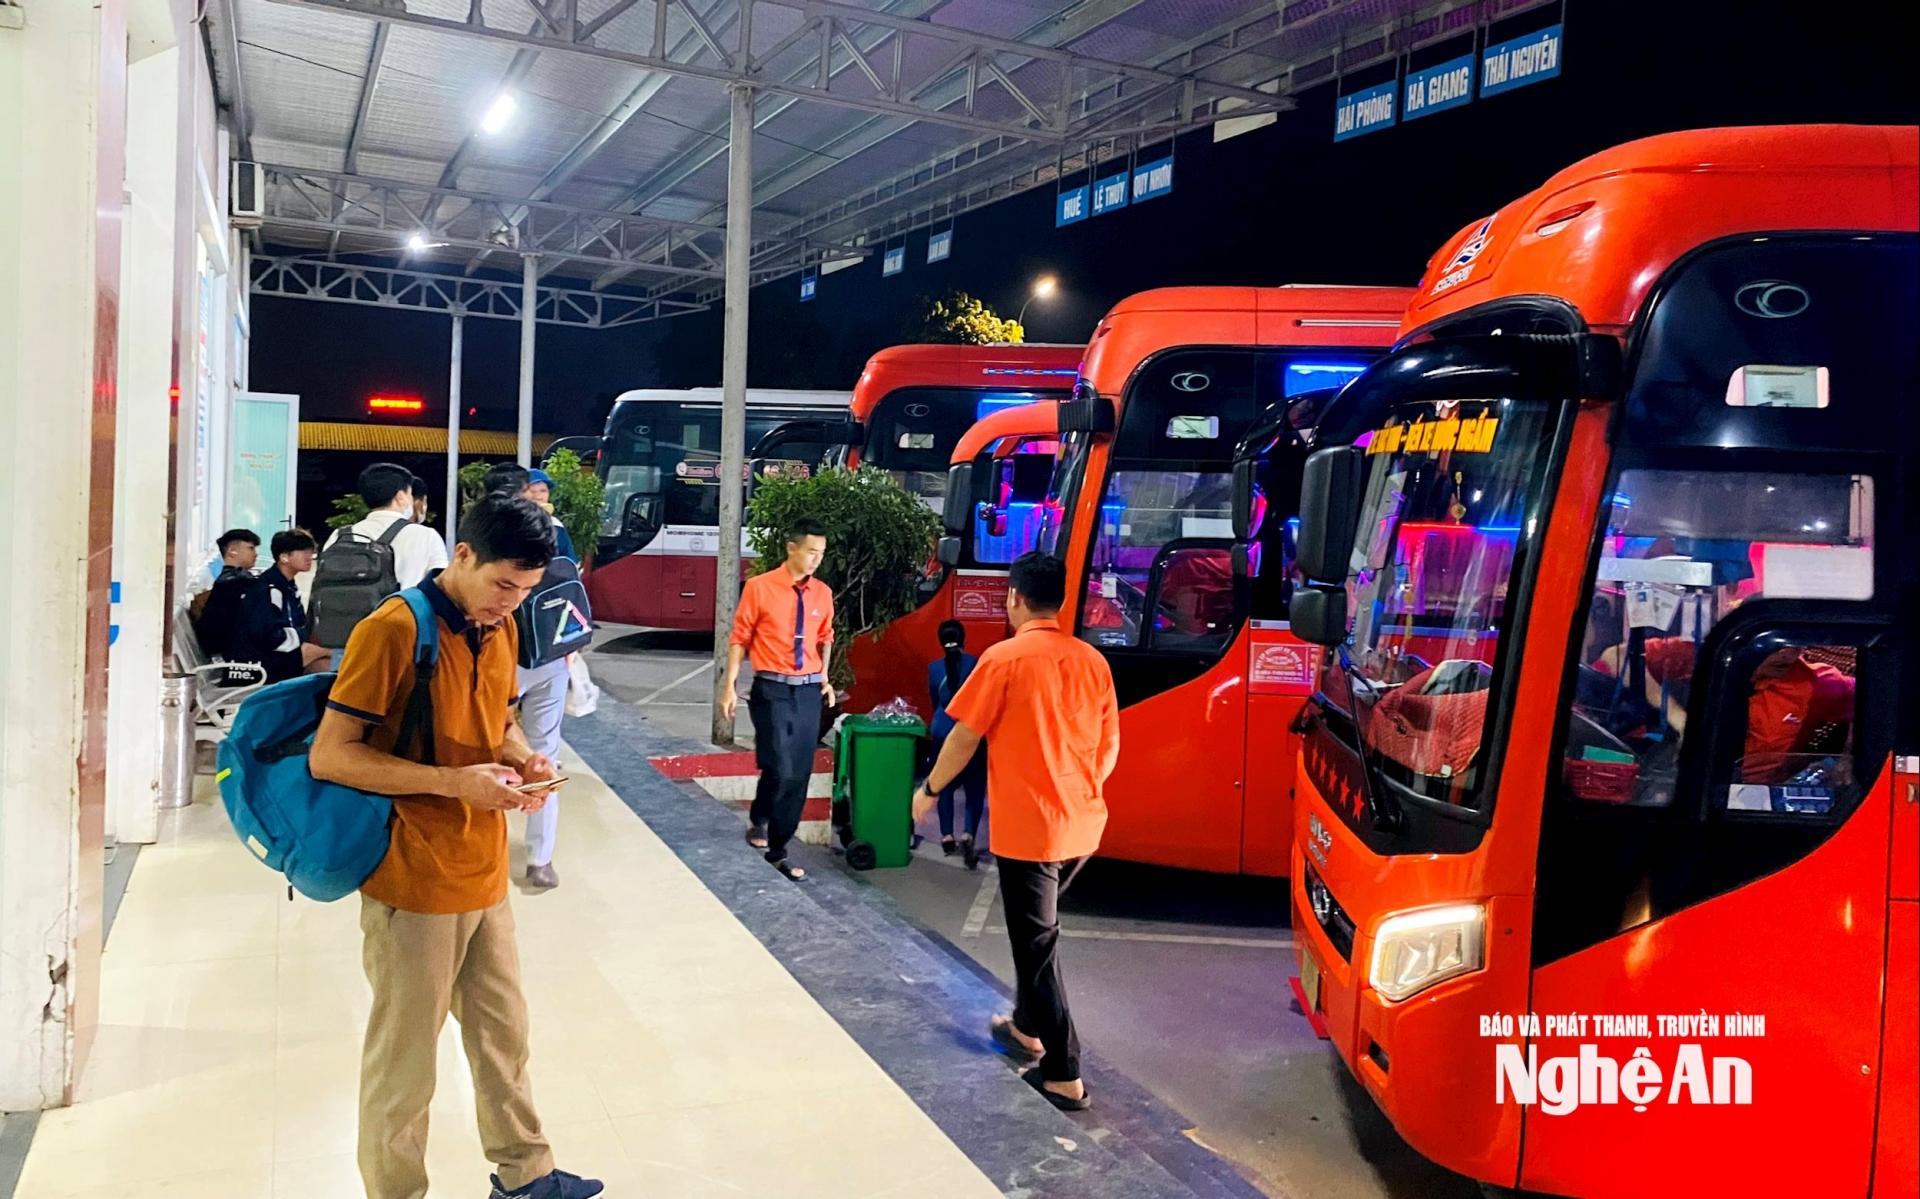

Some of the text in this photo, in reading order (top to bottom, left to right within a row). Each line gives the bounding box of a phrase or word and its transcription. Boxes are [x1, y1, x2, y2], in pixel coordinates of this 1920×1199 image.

[1484, 34, 1558, 88] THÁI NGUYÊN
[1407, 65, 1470, 112] HÀ GIANG
[1337, 91, 1393, 134] HẢI PHÒNG
[1063, 189, 1082, 220] HUẾ
[228, 670, 255, 680] me.
